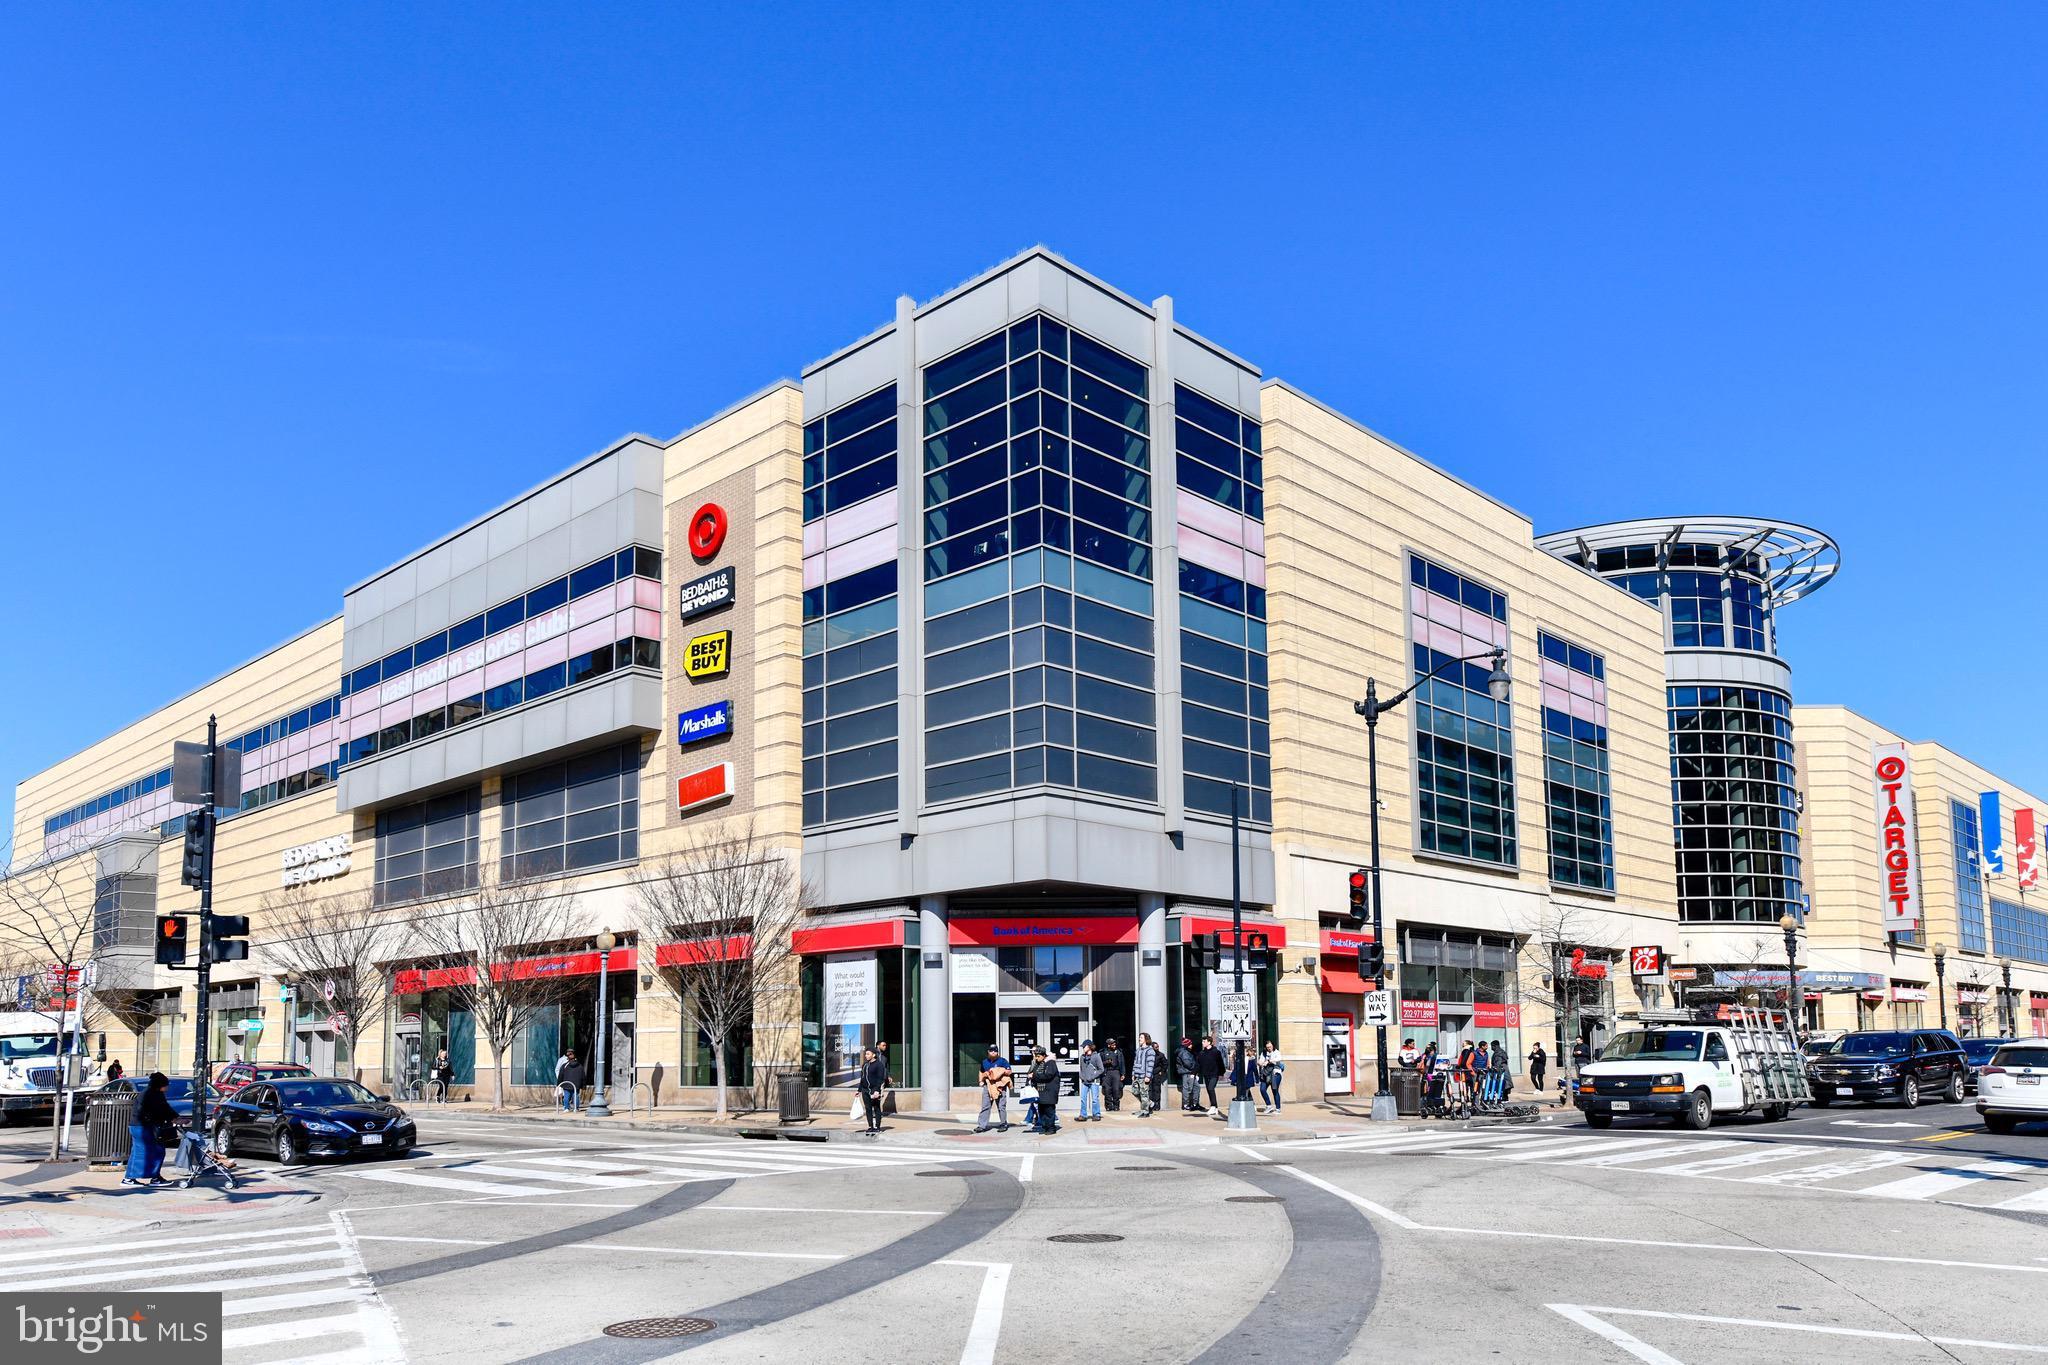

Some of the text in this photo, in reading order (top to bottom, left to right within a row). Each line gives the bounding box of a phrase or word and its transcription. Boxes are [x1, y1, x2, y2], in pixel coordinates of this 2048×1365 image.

[681, 588, 729, 613] BEYOND
[691, 638, 725, 658] BEST
[377, 608, 576, 704] washington sports clubs
[691, 654, 721, 672] BUY
[679, 709, 726, 736] Marshalls
[1881, 783, 1910, 916] TARGET
[993, 926, 1073, 936] Bank of America
[834, 970, 865, 980] What would
[1815, 974, 1854, 983] BEST BUY
[834, 982, 844, 990] you
[845, 980, 854, 988] like
[834, 990, 850, 999] power
[1223, 995, 1248, 1003] DIAGONAL
[1368, 993, 1387, 1003] ONE
[1223, 1003, 1249, 1011] CROSSING
[1368, 1003, 1388, 1012] WAY
[1223, 1019, 1233, 1033] OK
